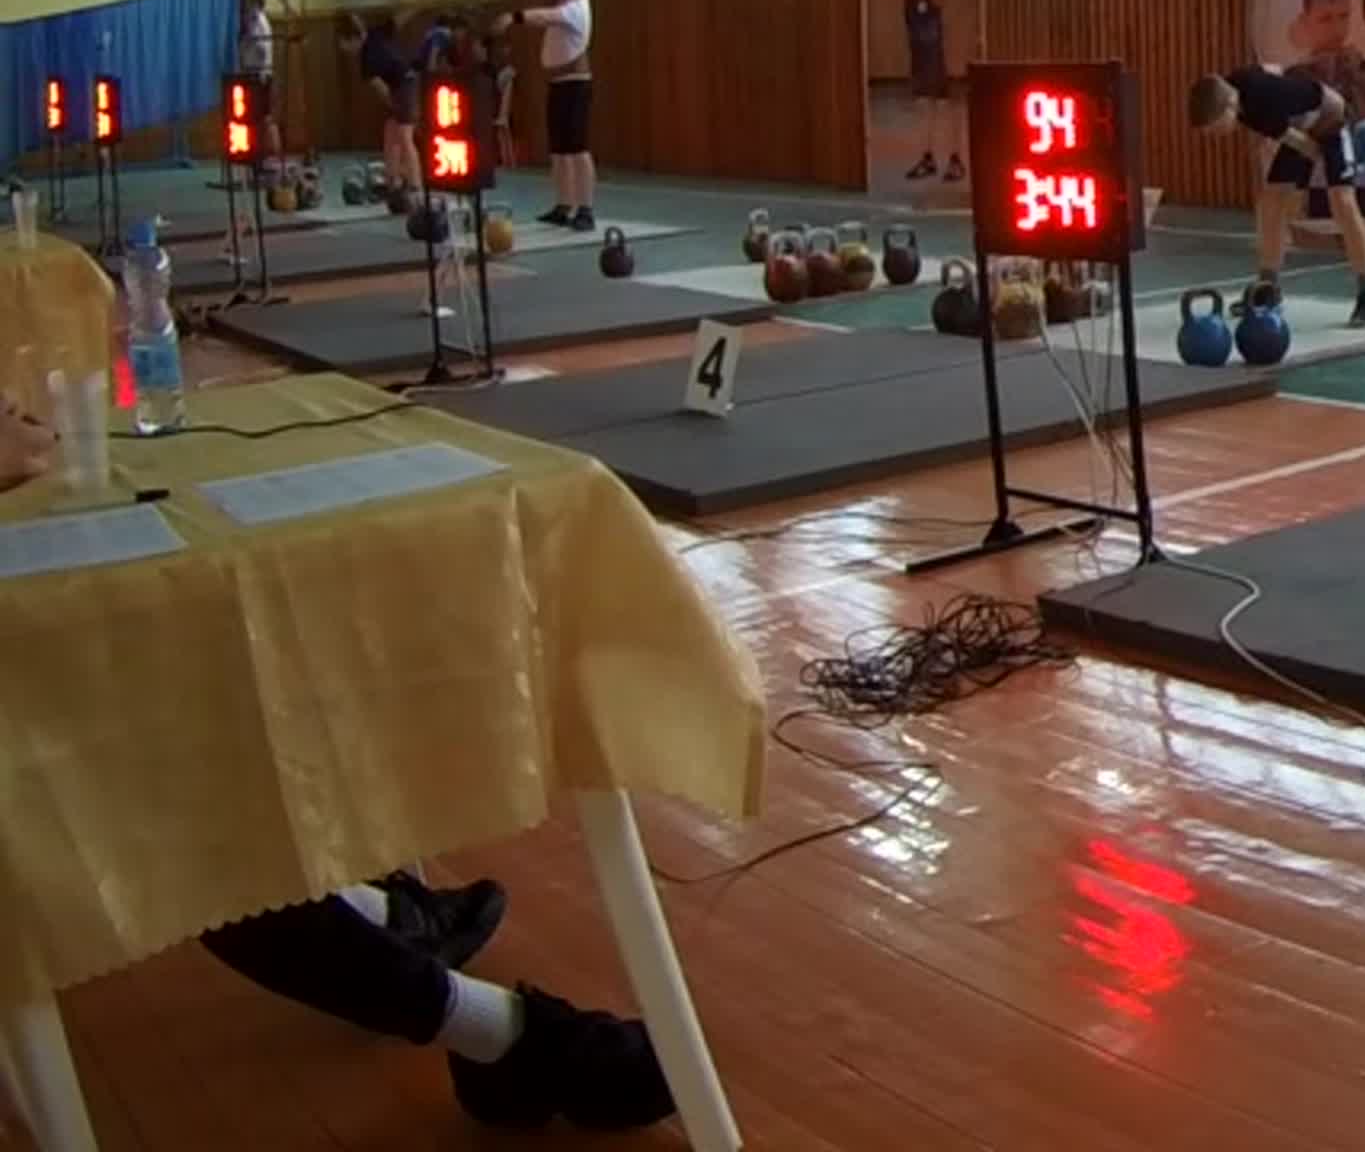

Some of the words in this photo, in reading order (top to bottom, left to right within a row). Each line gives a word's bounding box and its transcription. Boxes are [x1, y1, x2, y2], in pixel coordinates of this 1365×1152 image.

[1025, 91, 1076, 153] 94
[1013, 169, 1096, 231] 3:44
[697, 336, 726, 399] 4
